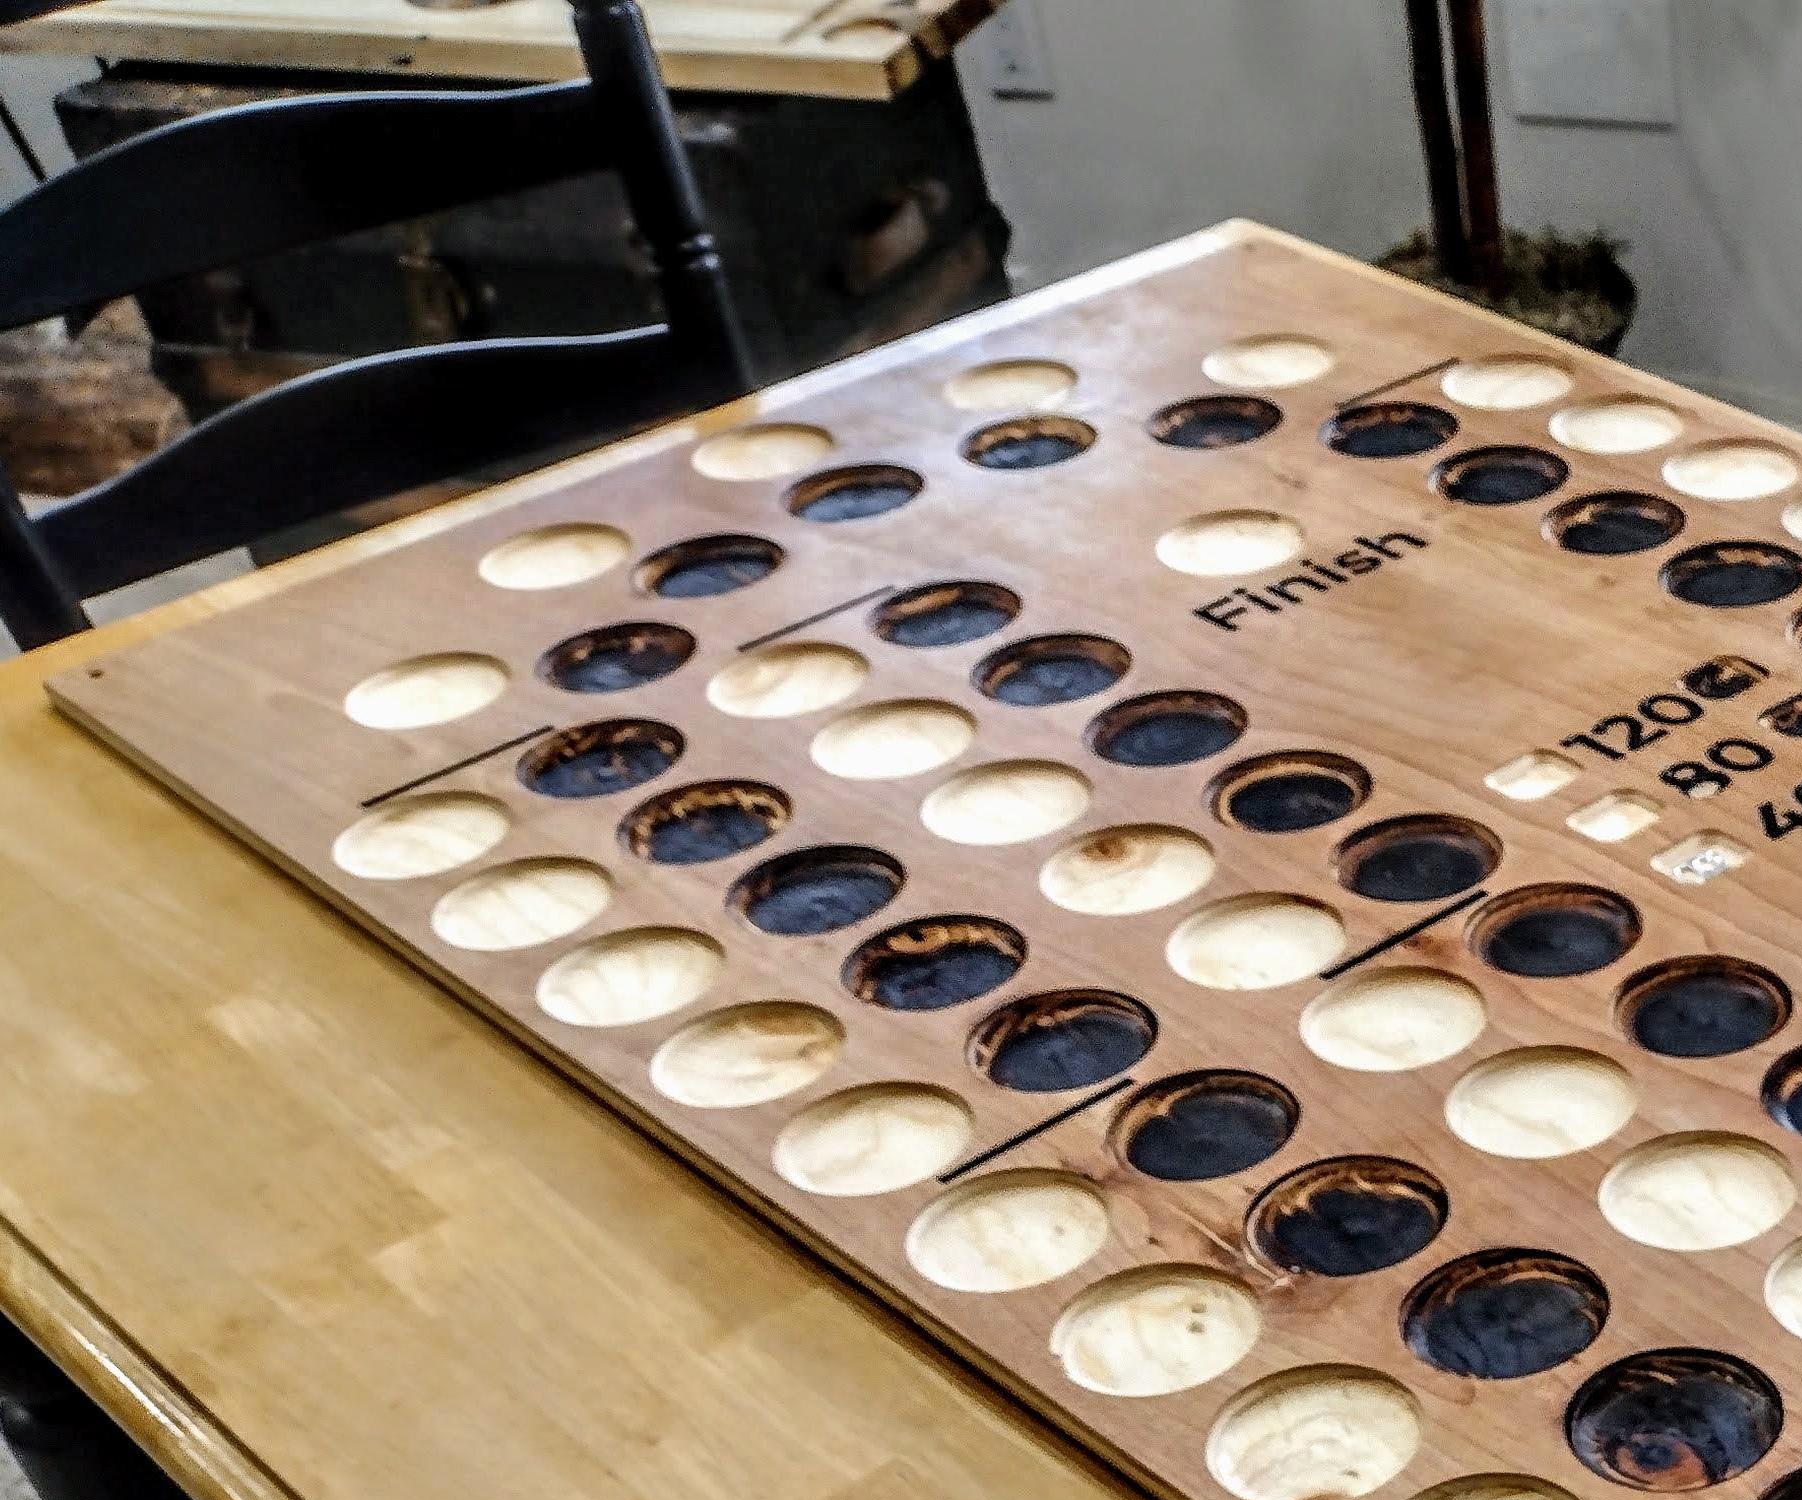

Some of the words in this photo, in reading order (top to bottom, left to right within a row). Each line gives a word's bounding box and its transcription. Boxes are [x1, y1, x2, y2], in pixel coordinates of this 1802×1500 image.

[1193, 532, 1429, 631] Finish
[1561, 694, 1704, 760] 120
[1660, 739, 1774, 798] 80
